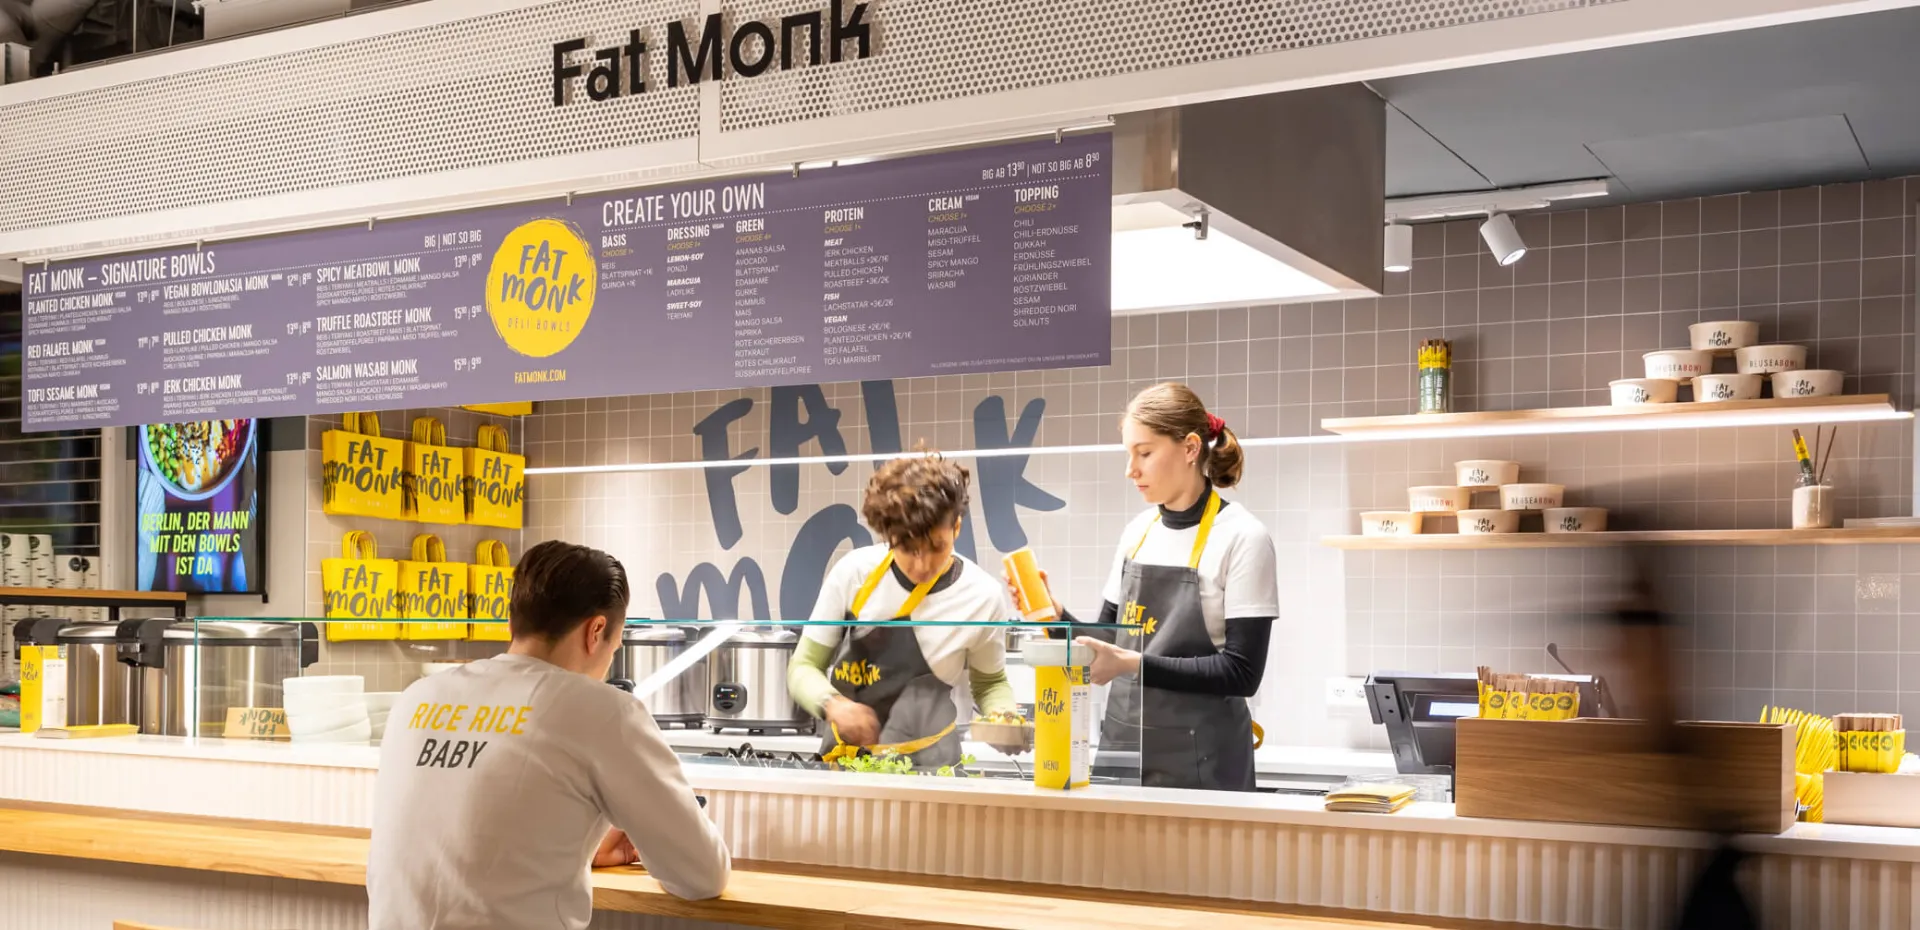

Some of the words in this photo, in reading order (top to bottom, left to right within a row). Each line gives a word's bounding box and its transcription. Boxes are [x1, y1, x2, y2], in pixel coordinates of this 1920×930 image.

[554, 30, 646, 107] Fat
[669, 0, 872, 88] Monk
[982, 168, 994, 181] BIG
[995, 167, 1005, 179] AB
[1031, 163, 1045, 175] NOT
[1048, 161, 1058, 173] SO
[1060, 159, 1071, 172] BIG
[1073, 157, 1084, 170] AB
[1014, 185, 1059, 203] TOPPING
[603, 195, 664, 228] CREATE
[671, 189, 716, 219] YOUR
[722, 183, 764, 213] OWN
[929, 196, 963, 212] CREAM
[1014, 204, 1046, 214] CHOOSE
[824, 206, 864, 223] PROTEIN
[928, 213, 959, 223] CHOOSE
[736, 218, 764, 233] GREEN
[928, 225, 968, 236] MARACUJA
[1014, 219, 1034, 228] CHILI
[424, 235, 436, 249] BIG
[442, 233, 456, 246] NOT
[458, 231, 468, 244] SO
[469, 229, 482, 243] BIG
[667, 225, 710, 241] DRESSING
[602, 234, 627, 248] BASIS
[824, 238, 843, 247] MEAT
[1014, 240, 1046, 250] DUKKAH
[736, 247, 763, 256] ANANAS
[763, 244, 785, 253] SALSA
[824, 248, 841, 258] JERK
[842, 245, 874, 255] CHICKEN
[928, 249, 954, 258] SESAM
[519, 240, 568, 281] FAT
[667, 253, 704, 263] LEMON-SOY
[736, 256, 767, 266] AVOCADO
[824, 257, 865, 268] MEATBALLS
[928, 259, 949, 269] SPICY
[950, 257, 979, 266] MANGO
[29, 272, 48, 295] FAT
[51, 268, 84, 292] MONK
[101, 257, 167, 287] SIGNATURE
[171, 251, 215, 279] BOWLS
[317, 266, 341, 283] SPICY
[343, 261, 391, 281] MEATBOWL
[394, 257, 420, 275] MONK
[602, 262, 616, 270] REIS
[736, 265, 780, 277] BLATTSPINAT
[824, 268, 850, 278] PULLED
[852, 266, 884, 276] CHICKEN
[667, 277, 701, 287] MARACUJA
[736, 276, 769, 287] EDAMAME
[928, 269, 965, 280] SRIRACHA
[1014, 272, 1058, 284] KORIANDER
[164, 284, 189, 300] VEGAN
[191, 276, 243, 298] BOWLONASIA
[245, 275, 269, 291] MONK
[602, 280, 626, 290] QUINOA
[824, 278, 864, 289] ROASTBEEF
[928, 281, 956, 291] WASABI
[501, 272, 585, 313] MONK
[735, 288, 758, 297] GURKE
[824, 293, 840, 301] FISH
[28, 299, 58, 315] PLANTED
[60, 296, 90, 311] CHICKEN
[92, 292, 113, 308] MONK
[667, 300, 703, 310] SWEET-SOY
[824, 300, 868, 312] LACHSTATAR
[1013, 296, 1041, 306] SESAM
[735, 309, 752, 317] MAIS
[1013, 305, 1056, 317] SHREDDED
[1057, 303, 1077, 313] NORI
[316, 316, 351, 332] TRUFFLE
[354, 310, 402, 329] ROASTBEEF
[405, 307, 432, 324] MONK
[508, 317, 530, 330] DELI
[537, 320, 570, 332] BOWLS
[735, 318, 760, 328] MANGO
[761, 316, 783, 326] SALSA
[824, 315, 848, 324] VEGAN
[164, 330, 191, 346] PULLED
[193, 326, 227, 343] CHICKEN
[229, 324, 252, 340] MONK
[735, 328, 762, 338] PAPRIKA
[824, 324, 866, 335] BOLOGNESE
[1712, 330, 1727, 340] FAT
[28, 345, 41, 359] RED
[43, 342, 70, 357] FALAFEL
[72, 340, 93, 354] MONK
[824, 346, 838, 356] RED
[839, 344, 868, 354] FALAFEL
[824, 357, 841, 366] TOFU
[843, 354, 882, 364] MARINIERT
[316, 364, 352, 381] SALMON
[354, 360, 389, 377] WASABI
[391, 358, 418, 375] MONK
[514, 369, 566, 384] FATMONK.COM
[164, 379, 181, 394] JERK
[183, 376, 216, 392] CHICKEN
[218, 374, 242, 390] MONK
[28, 389, 45, 403] TOFU
[47, 386, 75, 401] SESAME
[77, 384, 98, 399] MONK
[348, 439, 388, 470] FAT
[422, 450, 451, 478] FAT
[483, 456, 512, 485] FAT
[335, 460, 403, 495] MONK
[416, 473, 465, 503] MONK
[473, 474, 525, 508] MONK
[142, 512, 184, 533] BERLIN,
[187, 511, 210, 531] DER
[213, 510, 249, 530] MANN
[150, 534, 171, 553] MIT
[172, 534, 196, 553] DEN
[198, 533, 241, 553] BOWLS
[175, 556, 195, 575] IST
[196, 556, 213, 575] DA
[342, 564, 383, 596] FAT
[418, 566, 453, 595] FAT
[329, 588, 399, 619] MONK
[409, 589, 468, 618] MONK
[1125, 600, 1147, 622] FAT
[1043, 688, 1058, 703] FAT
[1038, 700, 1065, 717] MONK
[409, 703, 468, 732] RICE
[467, 705, 533, 735] RICE
[416, 738, 488, 769] BABY
[1043, 760, 1060, 771] MENU
